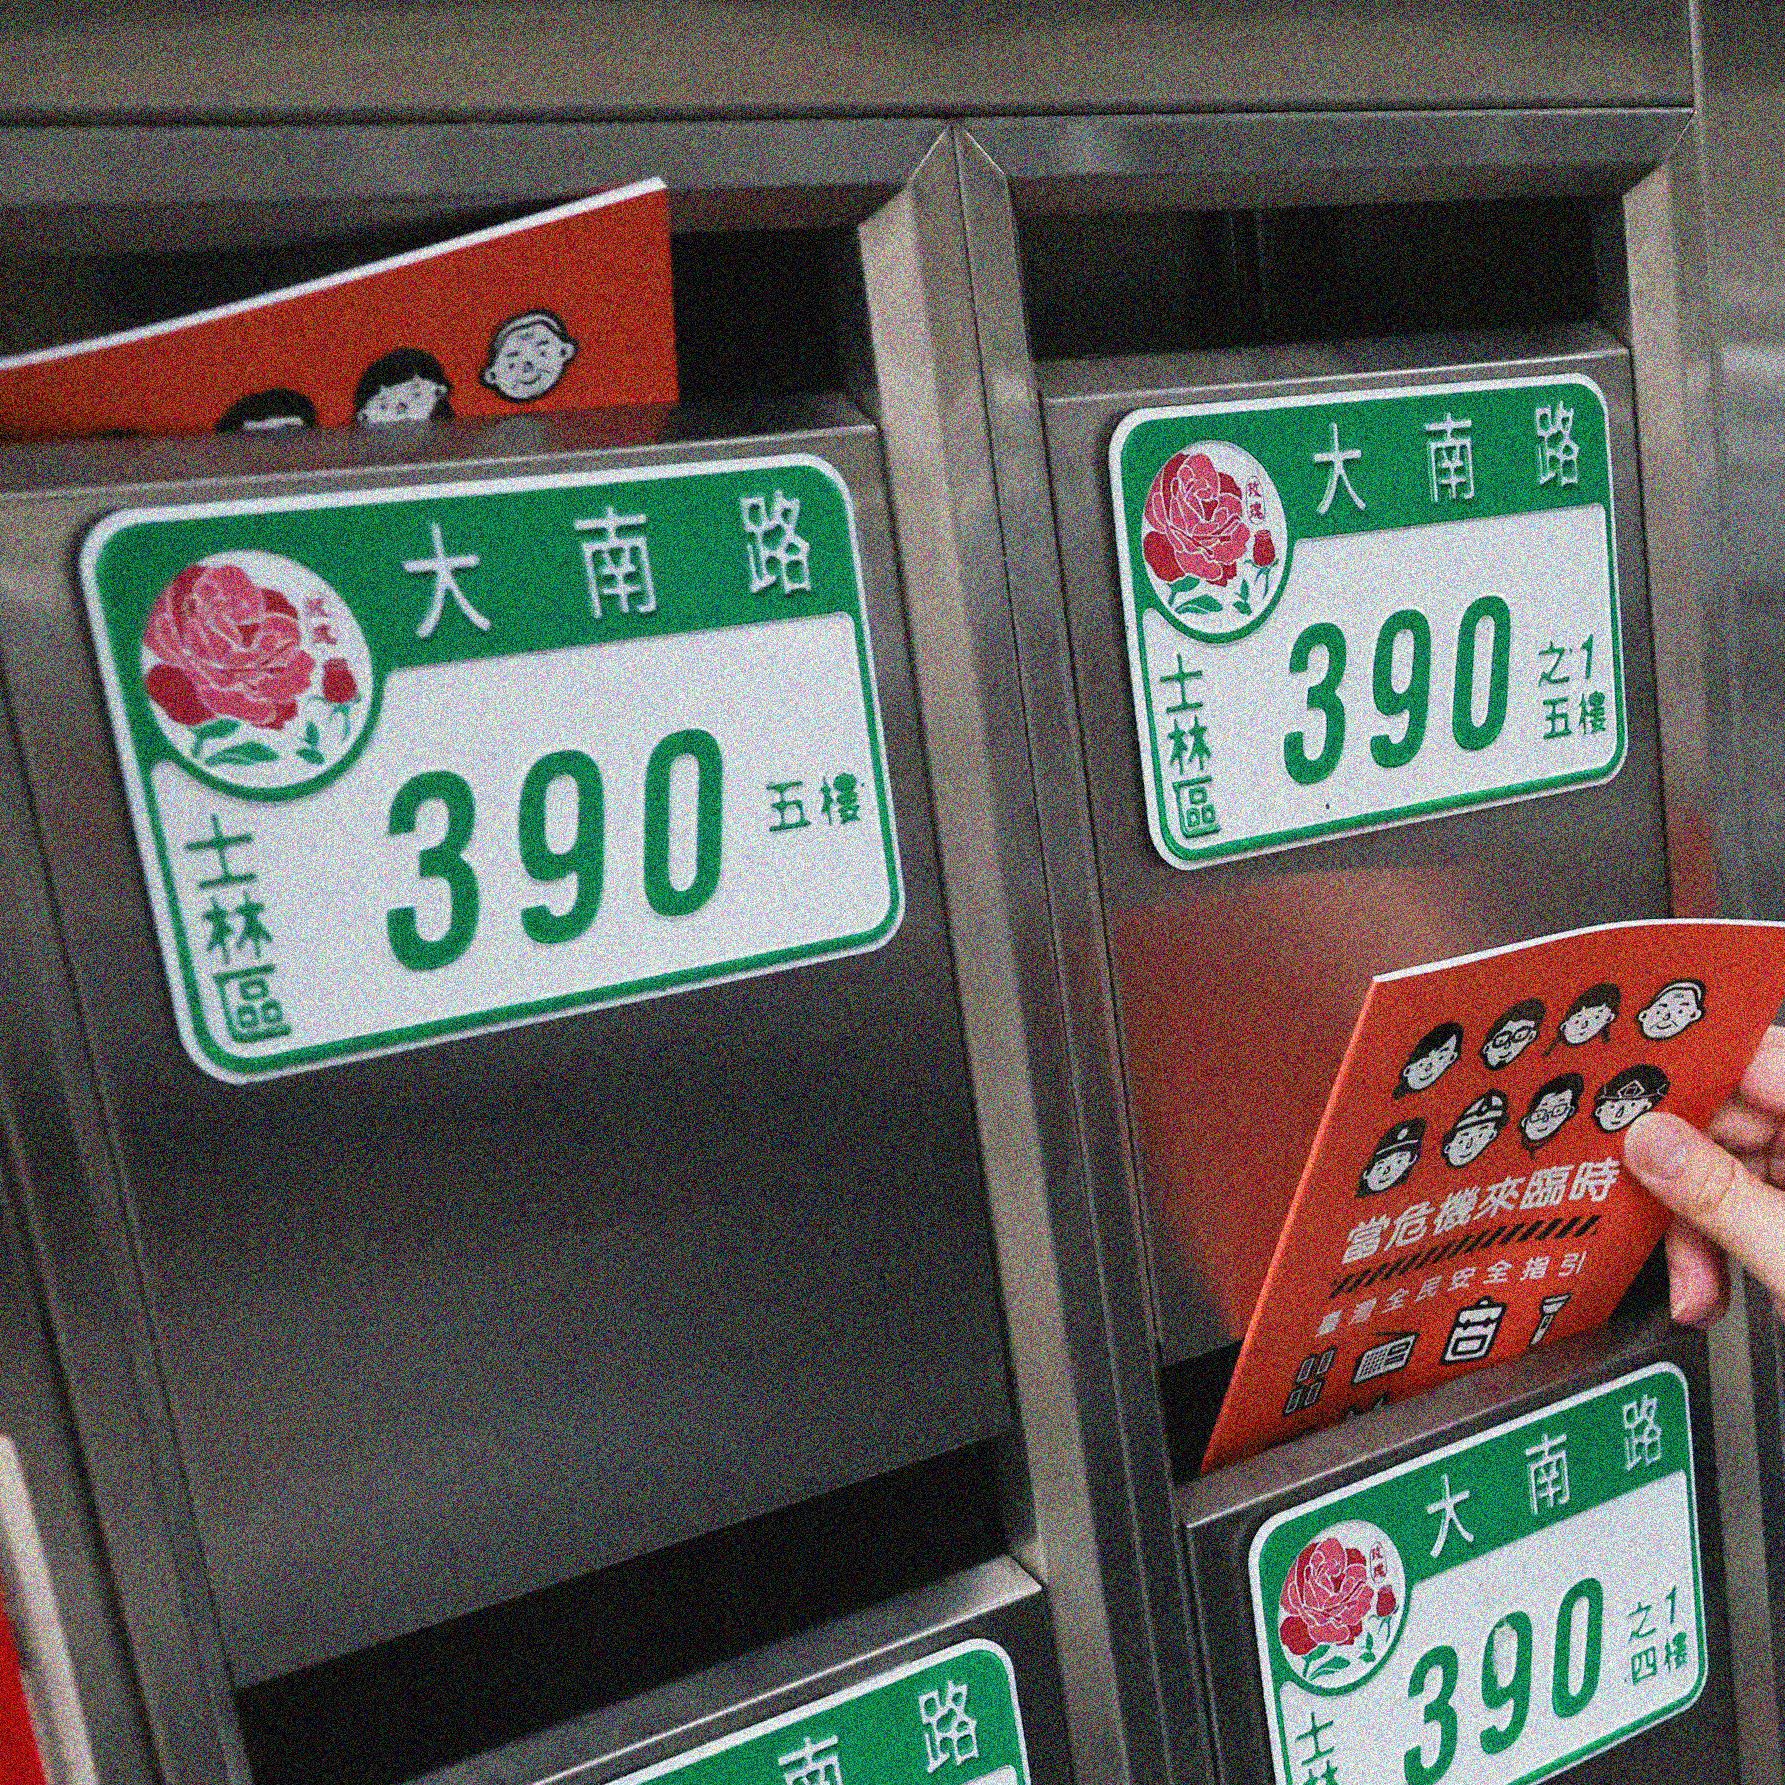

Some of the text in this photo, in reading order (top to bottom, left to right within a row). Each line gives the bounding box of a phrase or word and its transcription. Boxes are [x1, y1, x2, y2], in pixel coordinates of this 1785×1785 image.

[1314, 400, 1581, 516] 大南路
[402, 490, 813, 640] 大南路
[1160, 655, 1220, 838] 士林區
[1283, 595, 1511, 786] 390
[1542, 693, 1606, 742] 五樓
[385, 726, 724, 972] 390
[766, 772, 867, 834] 五樓
[185, 812, 291, 1043] 士林區
[1340, 1156, 1621, 1266] 當危機來臨時
[1425, 1393, 1664, 1558] 大南路
